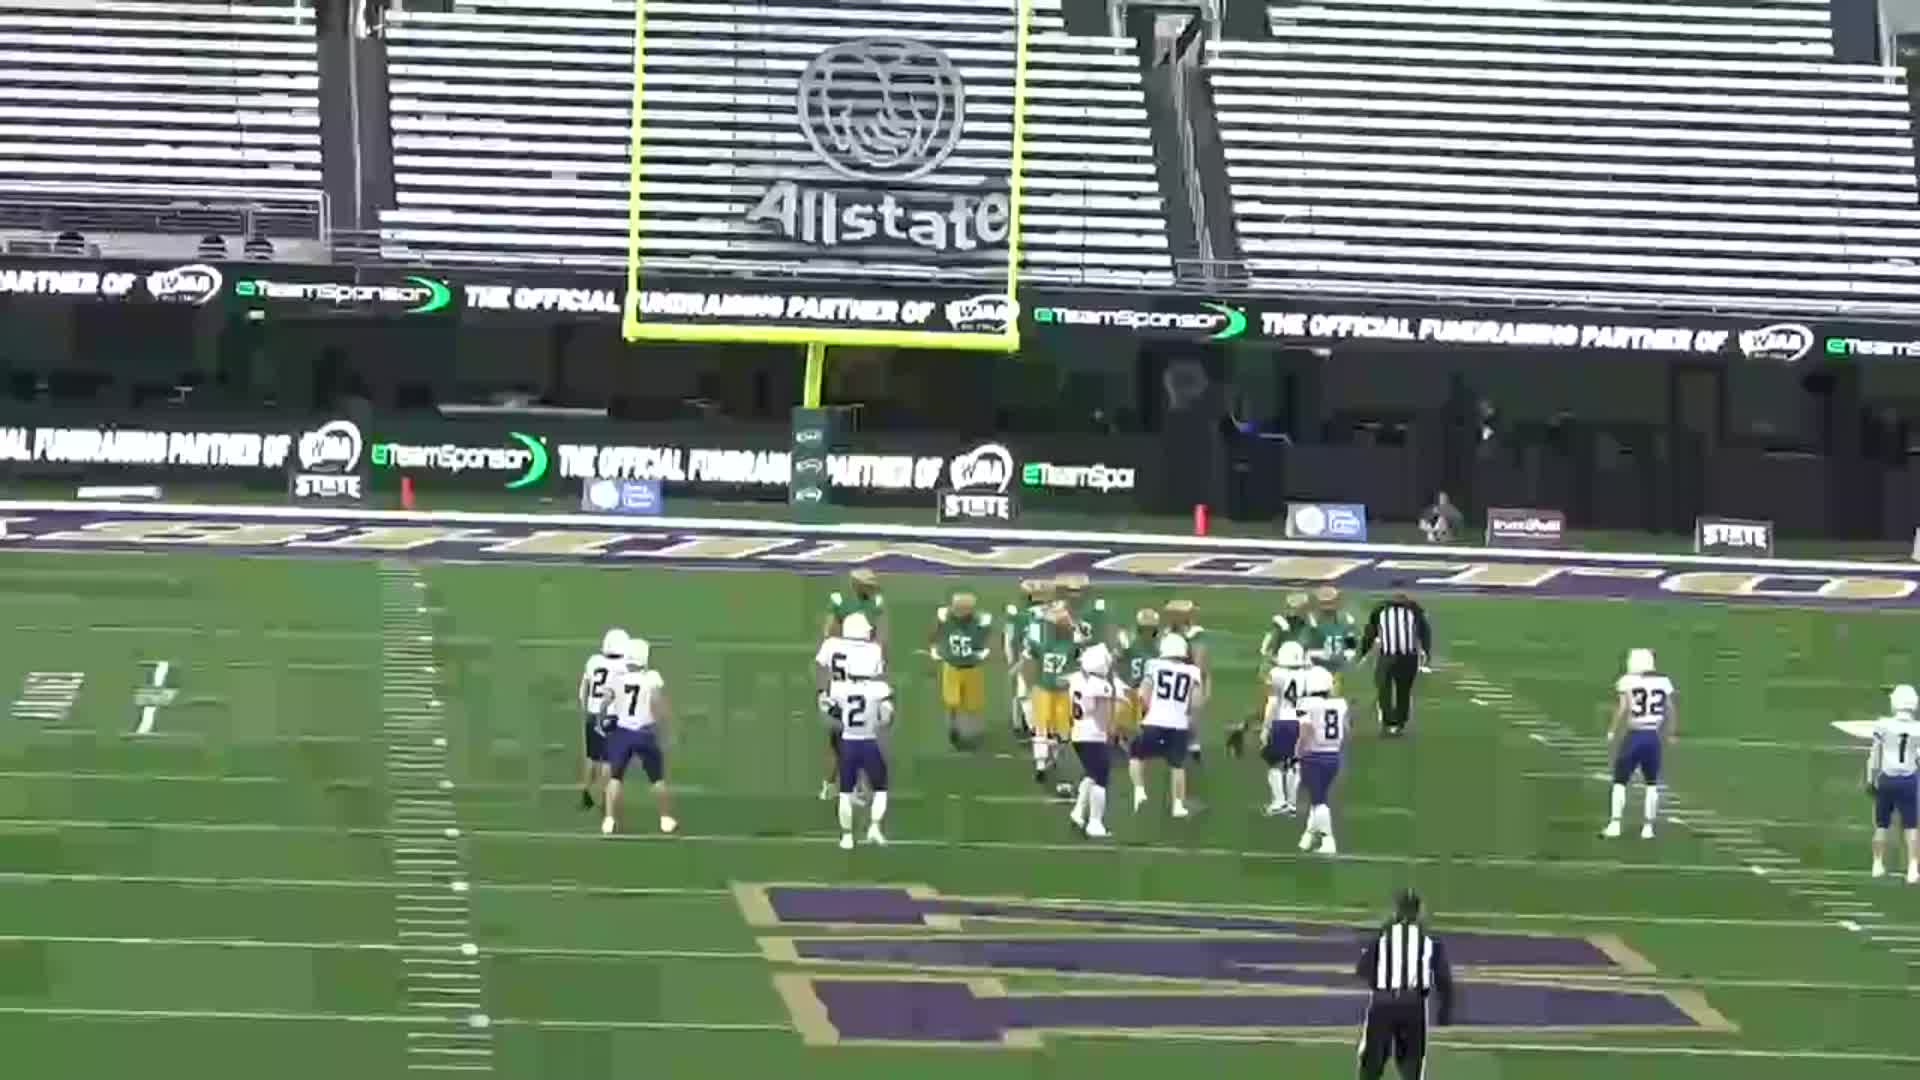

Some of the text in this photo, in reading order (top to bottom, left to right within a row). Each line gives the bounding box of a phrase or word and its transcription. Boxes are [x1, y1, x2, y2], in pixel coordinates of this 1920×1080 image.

[747, 180, 1010, 250] Allstate
[101, 271, 137, 295] OF
[465, 285, 511, 308] THE
[514, 286, 621, 313] OFFICIAL
[639, 291, 785, 318] UNDRAISING
[786, 296, 897, 322] PARTNER
[901, 301, 937, 324] OF
[1034, 307, 1226, 331] eTeamSponsor
[1261, 312, 1308, 335] THE
[1310, 314, 1416, 340] OFFICIAL
[1581, 325, 1691, 351] PARTNER
[1693, 329, 1729, 353] OF
[169, 431, 262, 466] PARTNER
[263, 434, 291, 468] OF
[371, 443, 533, 473] eTeamSponsor
[557, 444, 597, 478] THE
[598, 446, 687, 480] OFFICIAL
[914, 456, 943, 489] OF
[945, 494, 1009, 519] STATE
[1703, 523, 1767, 549] STATE
[831, 652, 847, 681] 5
[624, 684, 641, 716] 7
[1156, 669, 1191, 703] 50
[1284, 677, 1298, 708] 4
[1631, 686, 1666, 718] 32
[847, 694, 866, 728] 2
[1324, 708, 1340, 740] 8
[1897, 732, 1910, 764] 1
